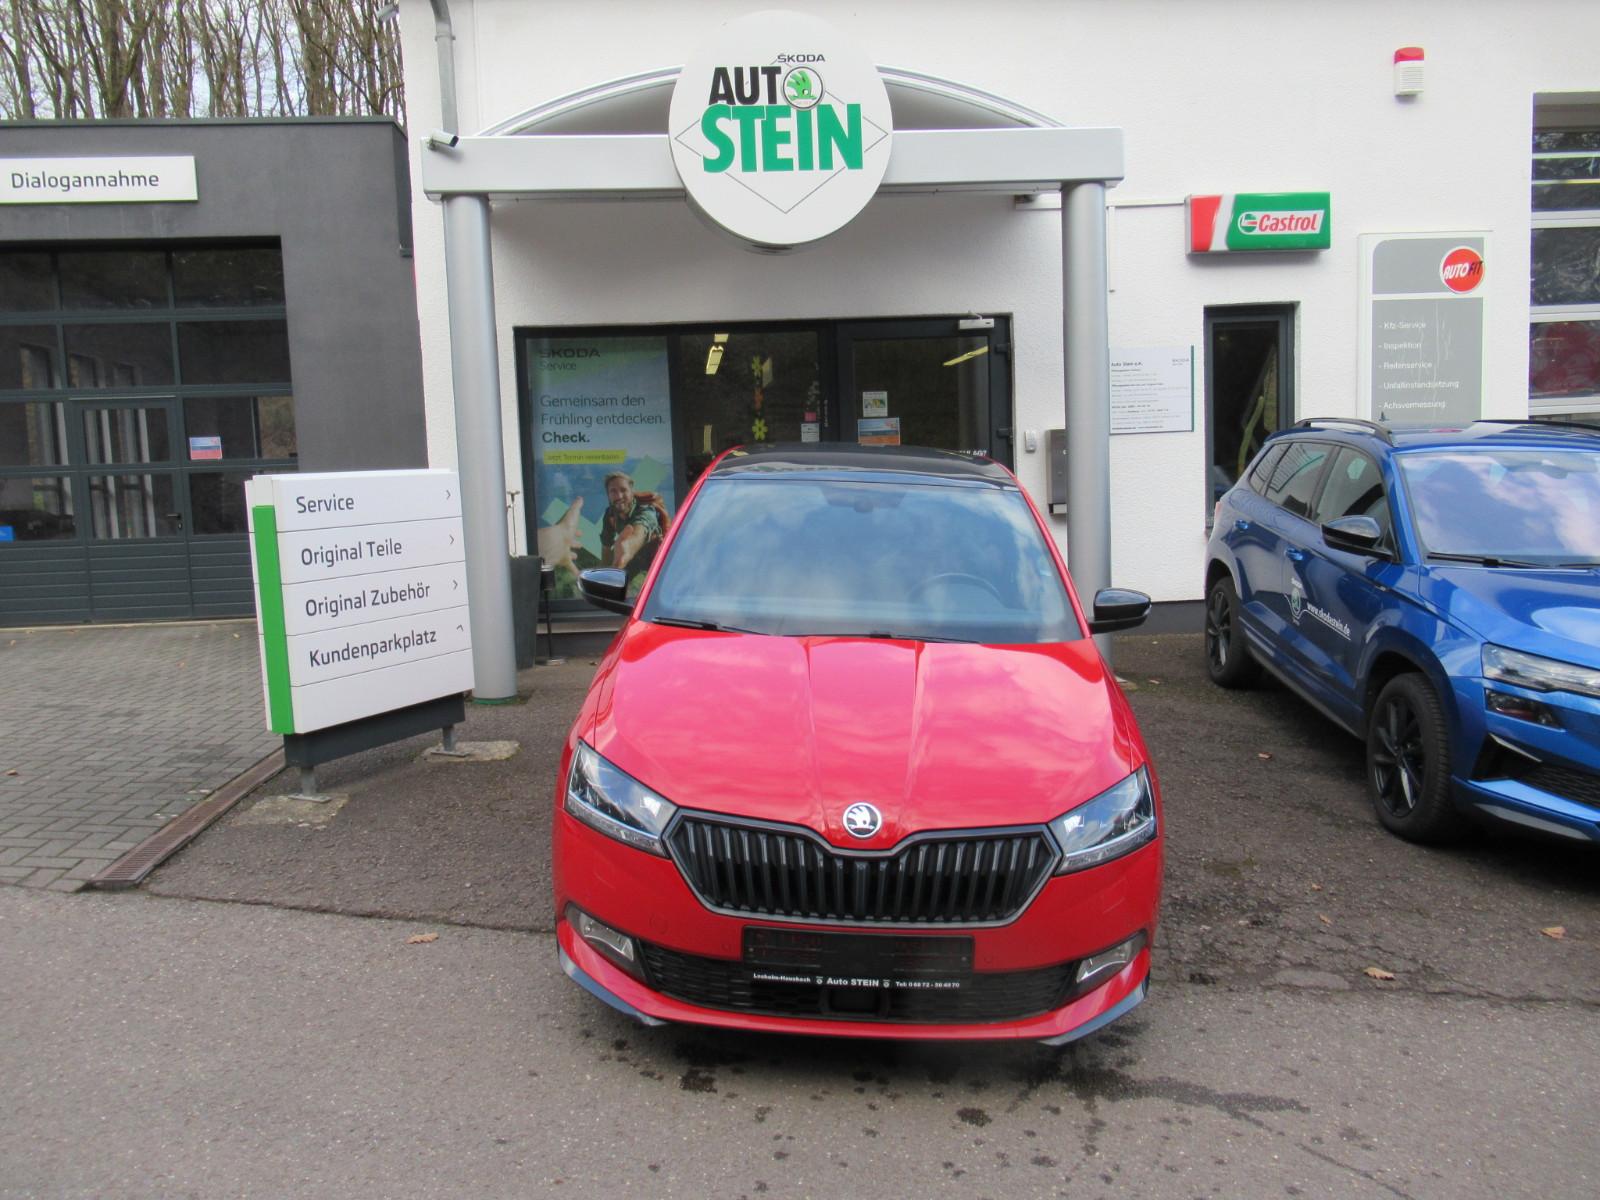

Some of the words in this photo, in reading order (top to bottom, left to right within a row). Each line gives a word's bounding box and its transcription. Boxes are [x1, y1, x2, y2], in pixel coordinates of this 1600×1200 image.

[701, 103, 864, 174] STEIN
[11, 170, 160, 192] Dialogannahme
[1258, 213, 1319, 233] Castrol
[540, 394, 618, 408] Gemeinsam
[621, 394, 646, 407] den
[541, 412, 593, 428] Frühling
[596, 412, 667, 425] entdecken.
[542, 431, 591, 444] Check.
[296, 493, 355, 514] Service
[301, 541, 363, 568] Original
[366, 538, 402, 558] Teile
[305, 590, 367, 618] Original
[370, 582, 431, 606] Zubehör
[309, 629, 437, 667] Kundenparkplatz
[827, 977, 849, 986] Auto
[850, 978, 880, 988] STEIN
